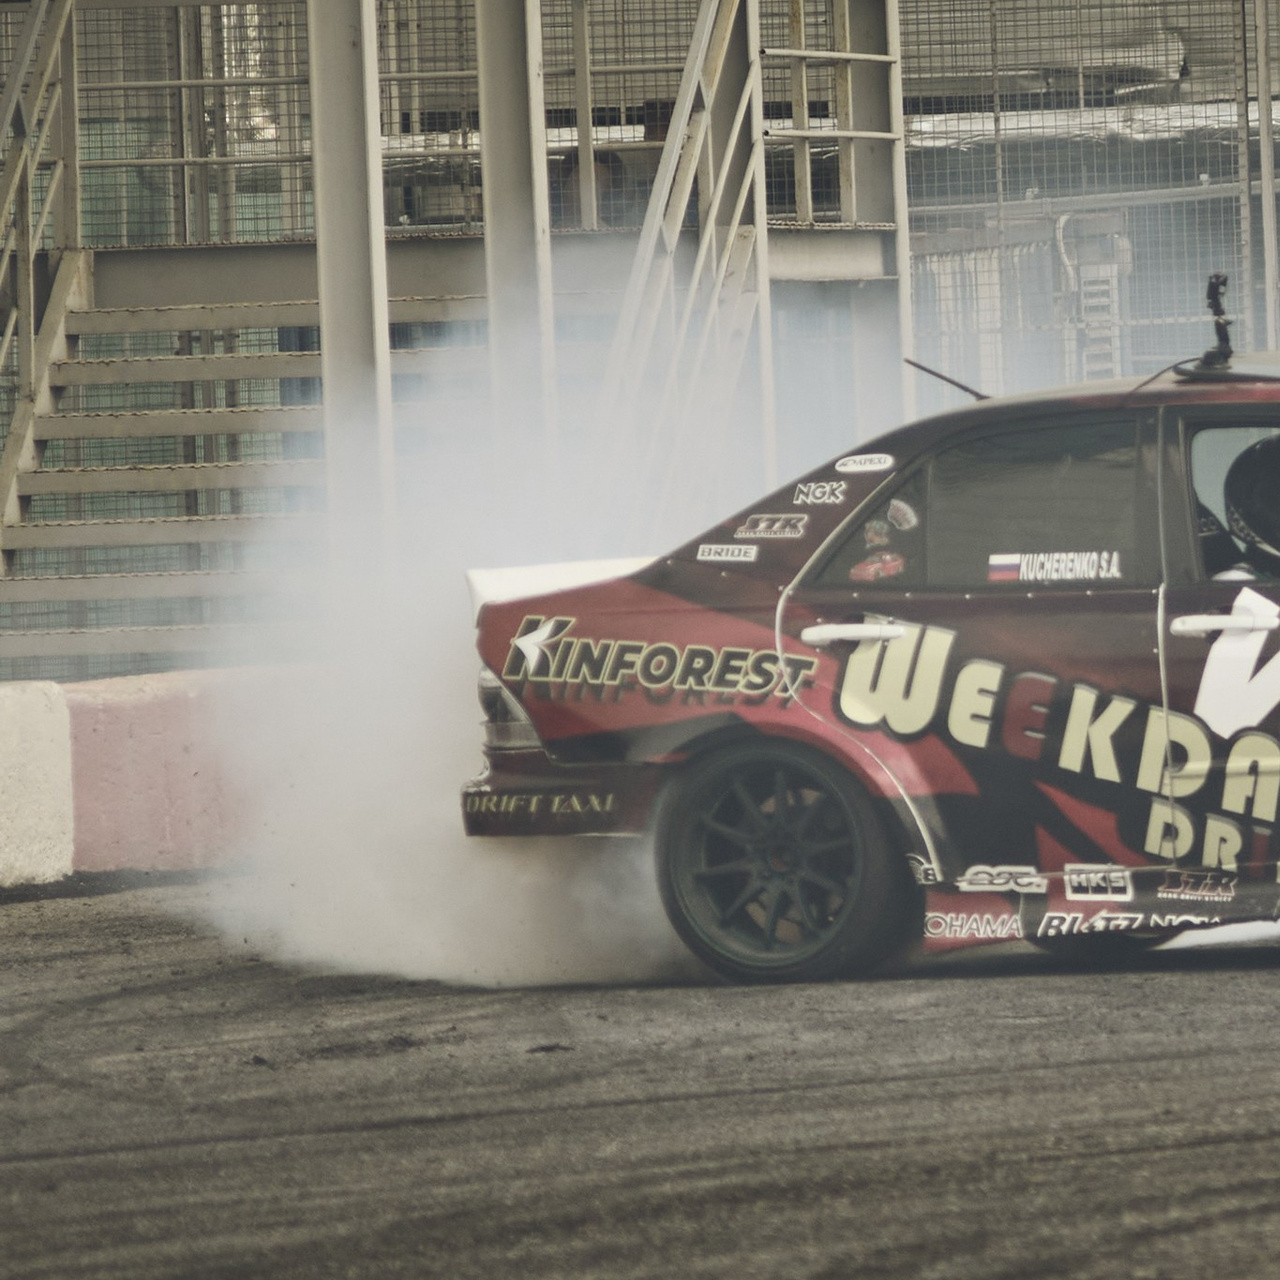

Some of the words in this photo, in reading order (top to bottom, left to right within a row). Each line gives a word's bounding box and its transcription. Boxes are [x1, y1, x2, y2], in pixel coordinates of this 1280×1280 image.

[793, 481, 846, 505] NGK
[700, 545, 754, 559] BRIDE
[1018, 552, 1098, 581] KUCHERENKO
[1099, 550, 1122, 579] S.A.
[503, 615, 819, 698] KINFOREST
[466, 793, 544, 813] DRIFT
[551, 792, 614, 813] TAXI
[1069, 871, 1128, 896] HKS
[924, 911, 1024, 938] OHAMA
